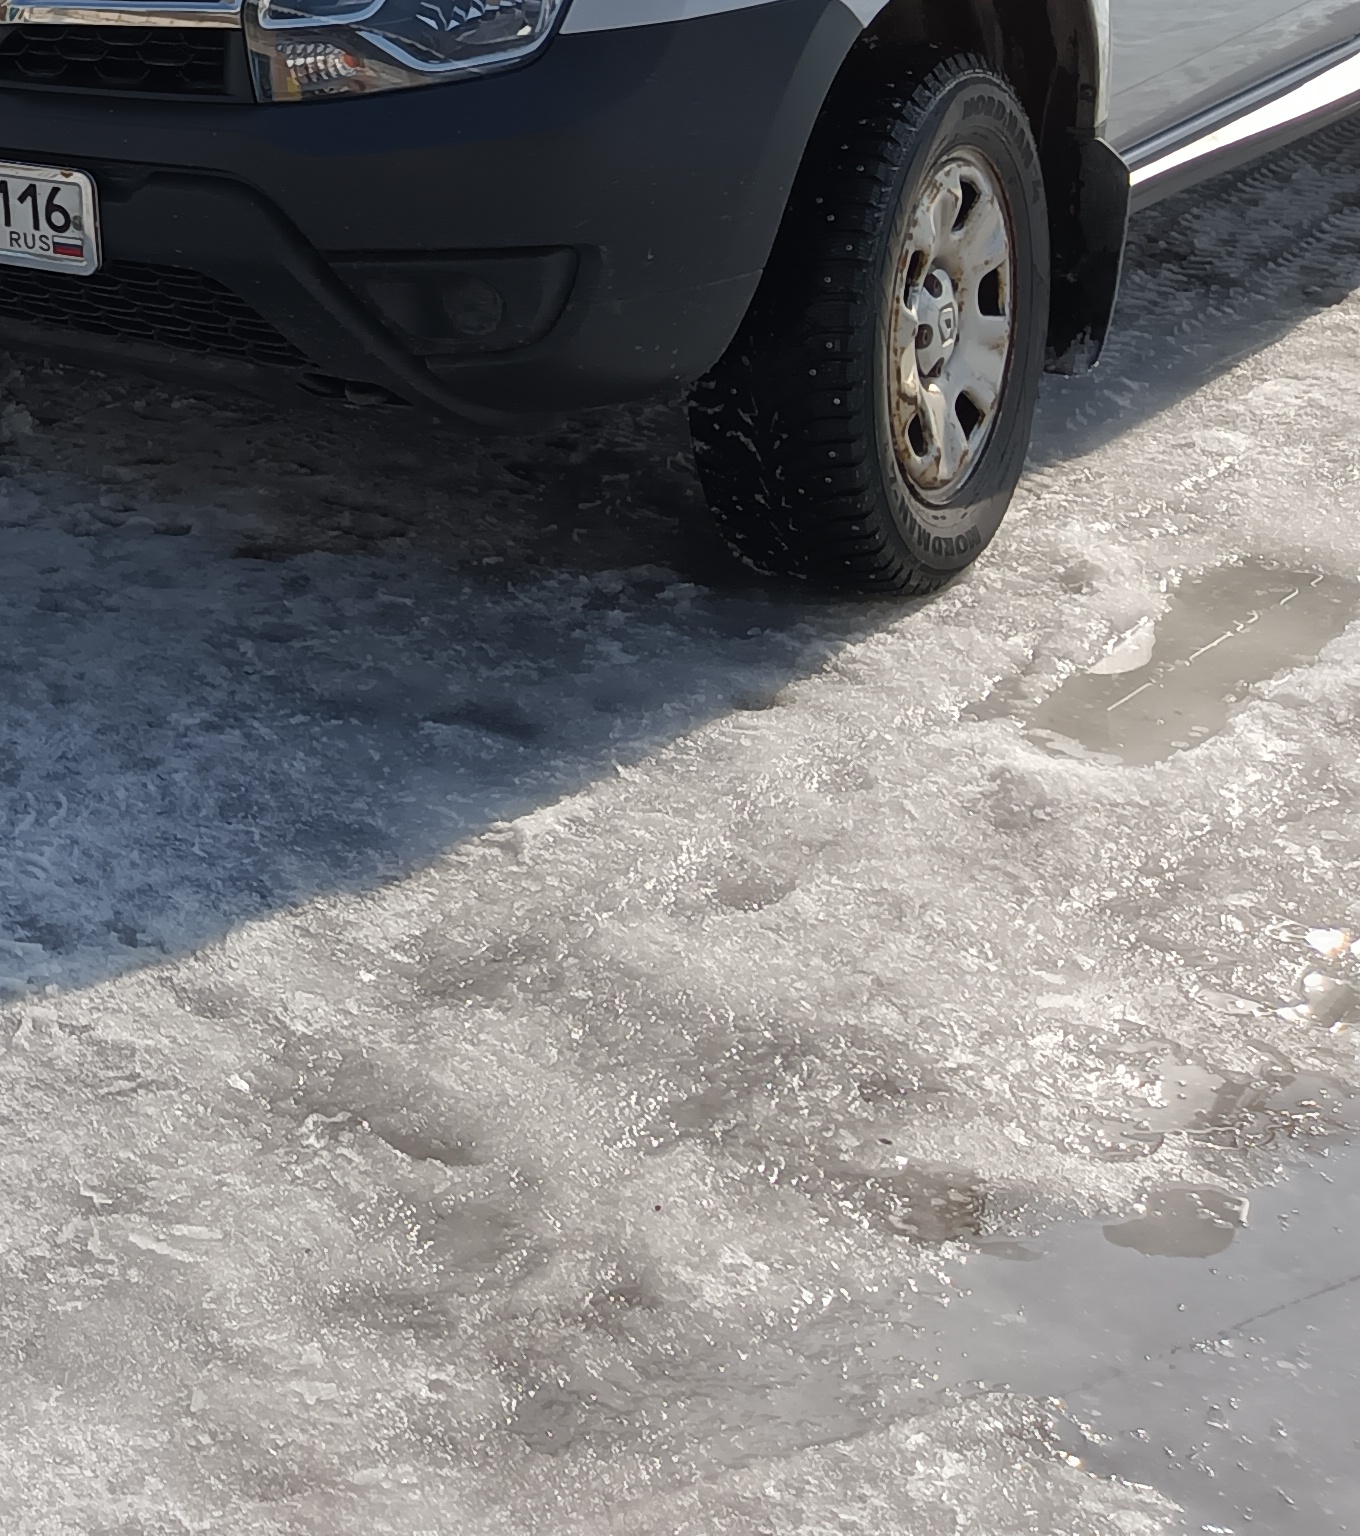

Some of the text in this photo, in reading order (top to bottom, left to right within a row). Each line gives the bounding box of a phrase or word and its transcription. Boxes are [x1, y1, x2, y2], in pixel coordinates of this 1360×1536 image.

[962, 94, 1034, 170] NORDMAN
[9, 230, 52, 253] RUS
[898, 495, 982, 557] NORDMAN
